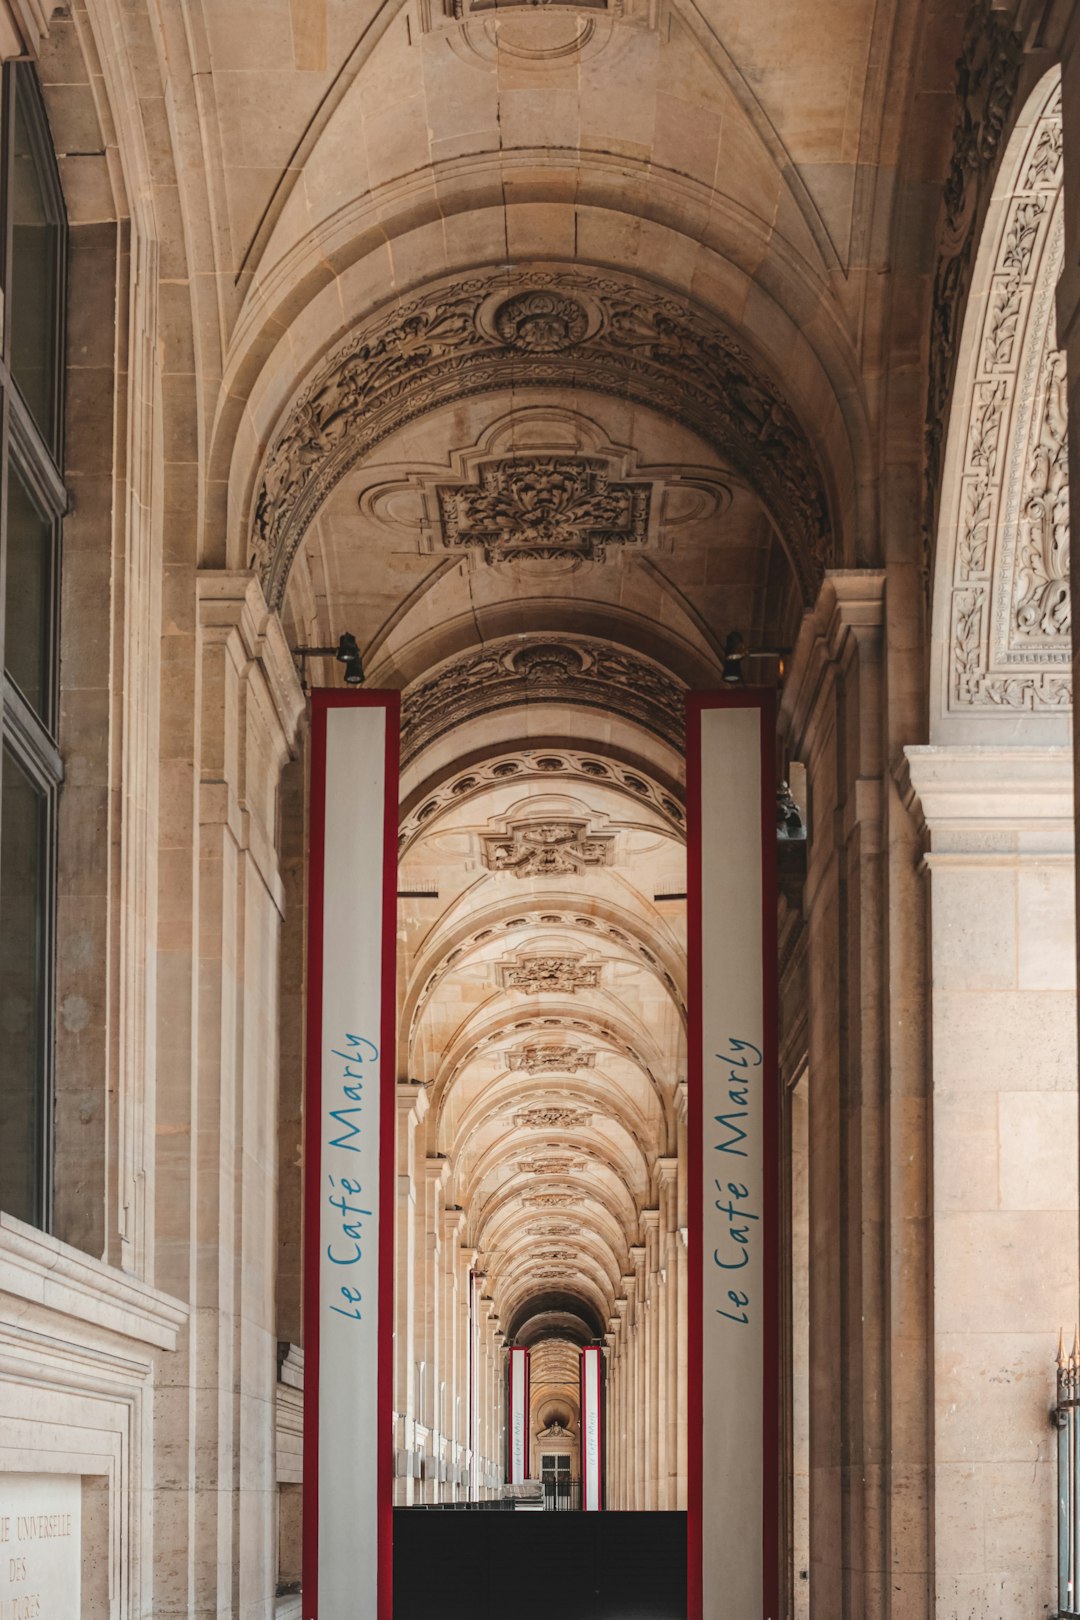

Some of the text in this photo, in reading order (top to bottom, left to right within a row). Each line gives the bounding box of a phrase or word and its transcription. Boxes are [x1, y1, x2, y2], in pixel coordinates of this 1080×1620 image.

[327, 1033, 379, 1320] Le Café Marly
[713, 1037, 763, 1325] Le Café Marly
[9, 1556, 27, 1582] DES
[17, 1514, 72, 1541] UNIVERSELLE
